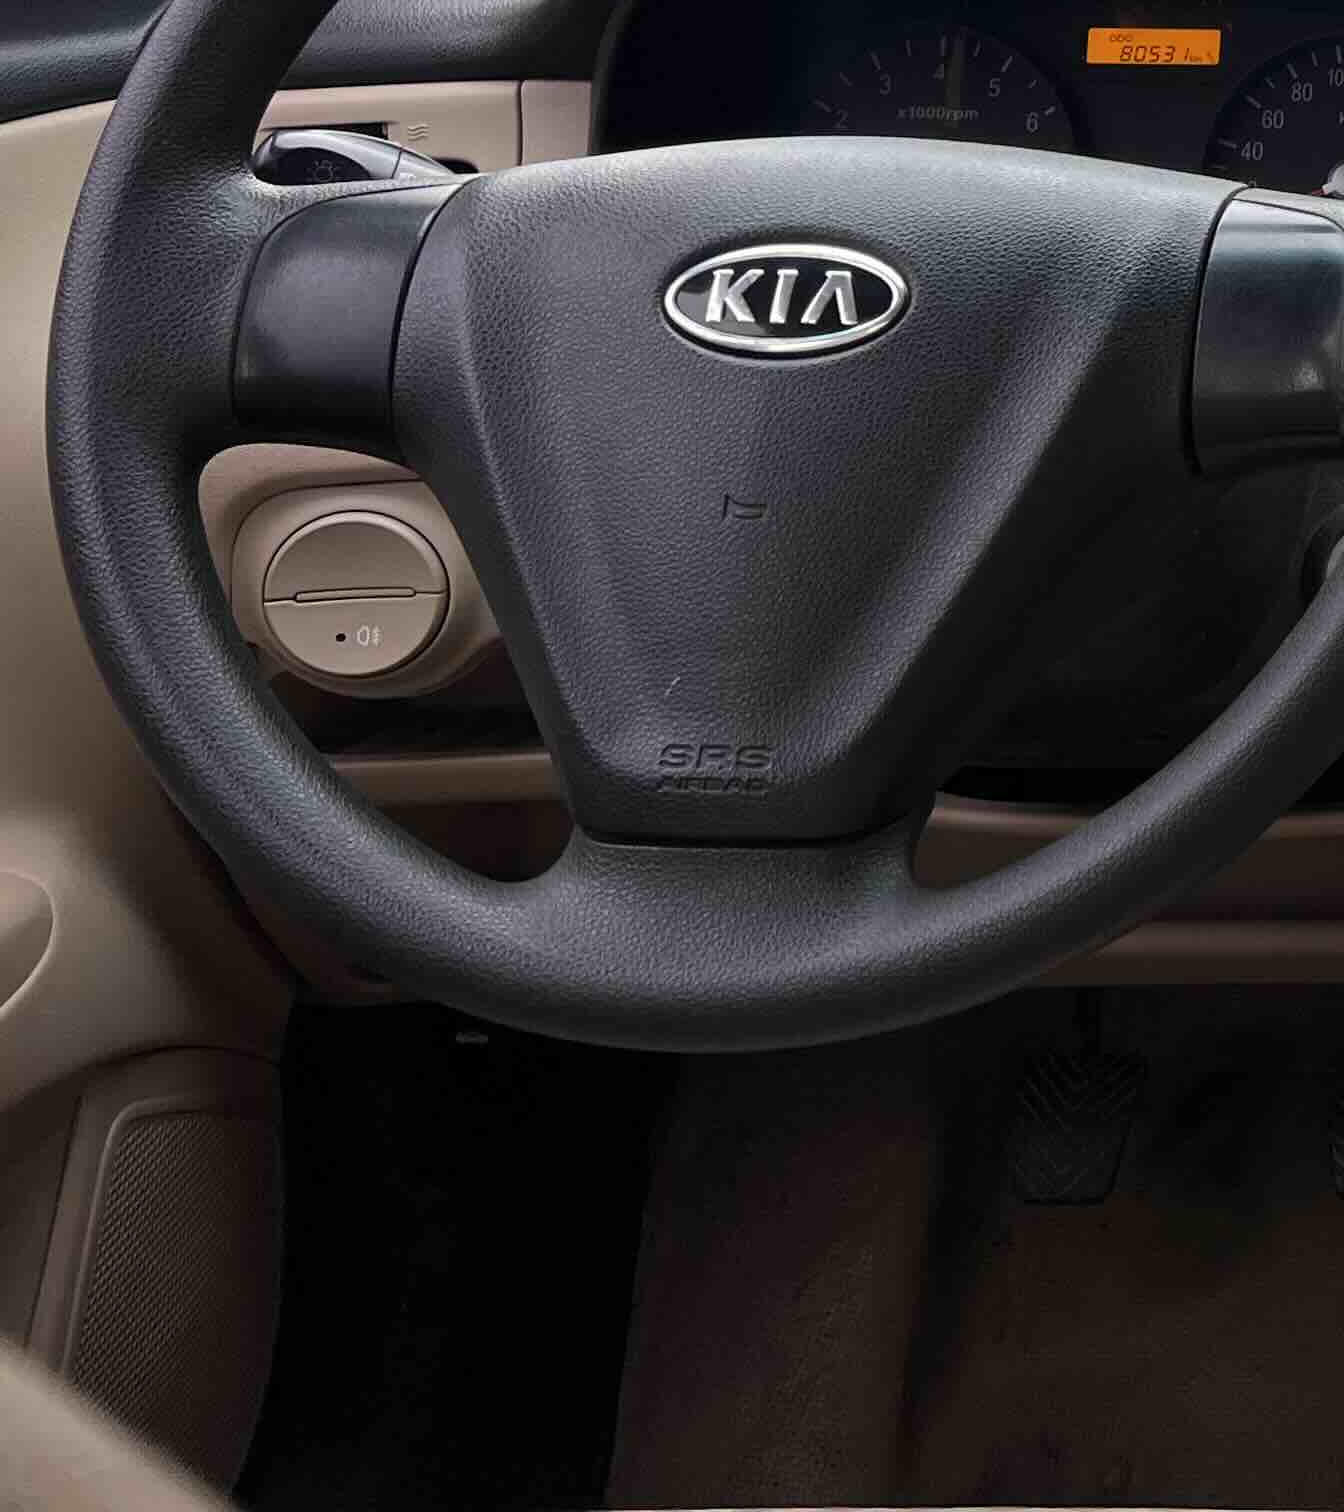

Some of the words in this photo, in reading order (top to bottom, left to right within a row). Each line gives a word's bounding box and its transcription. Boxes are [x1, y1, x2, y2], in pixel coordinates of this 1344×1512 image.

[1120, 45, 1190, 62] 80531
[987, 78, 1001, 97] 5
[1290, 82, 1313, 102] 80
[1026, 112, 1040, 132] 6
[1262, 109, 1285, 129] 60
[1240, 141, 1264, 161] 40
[705, 268, 859, 325] KIA
